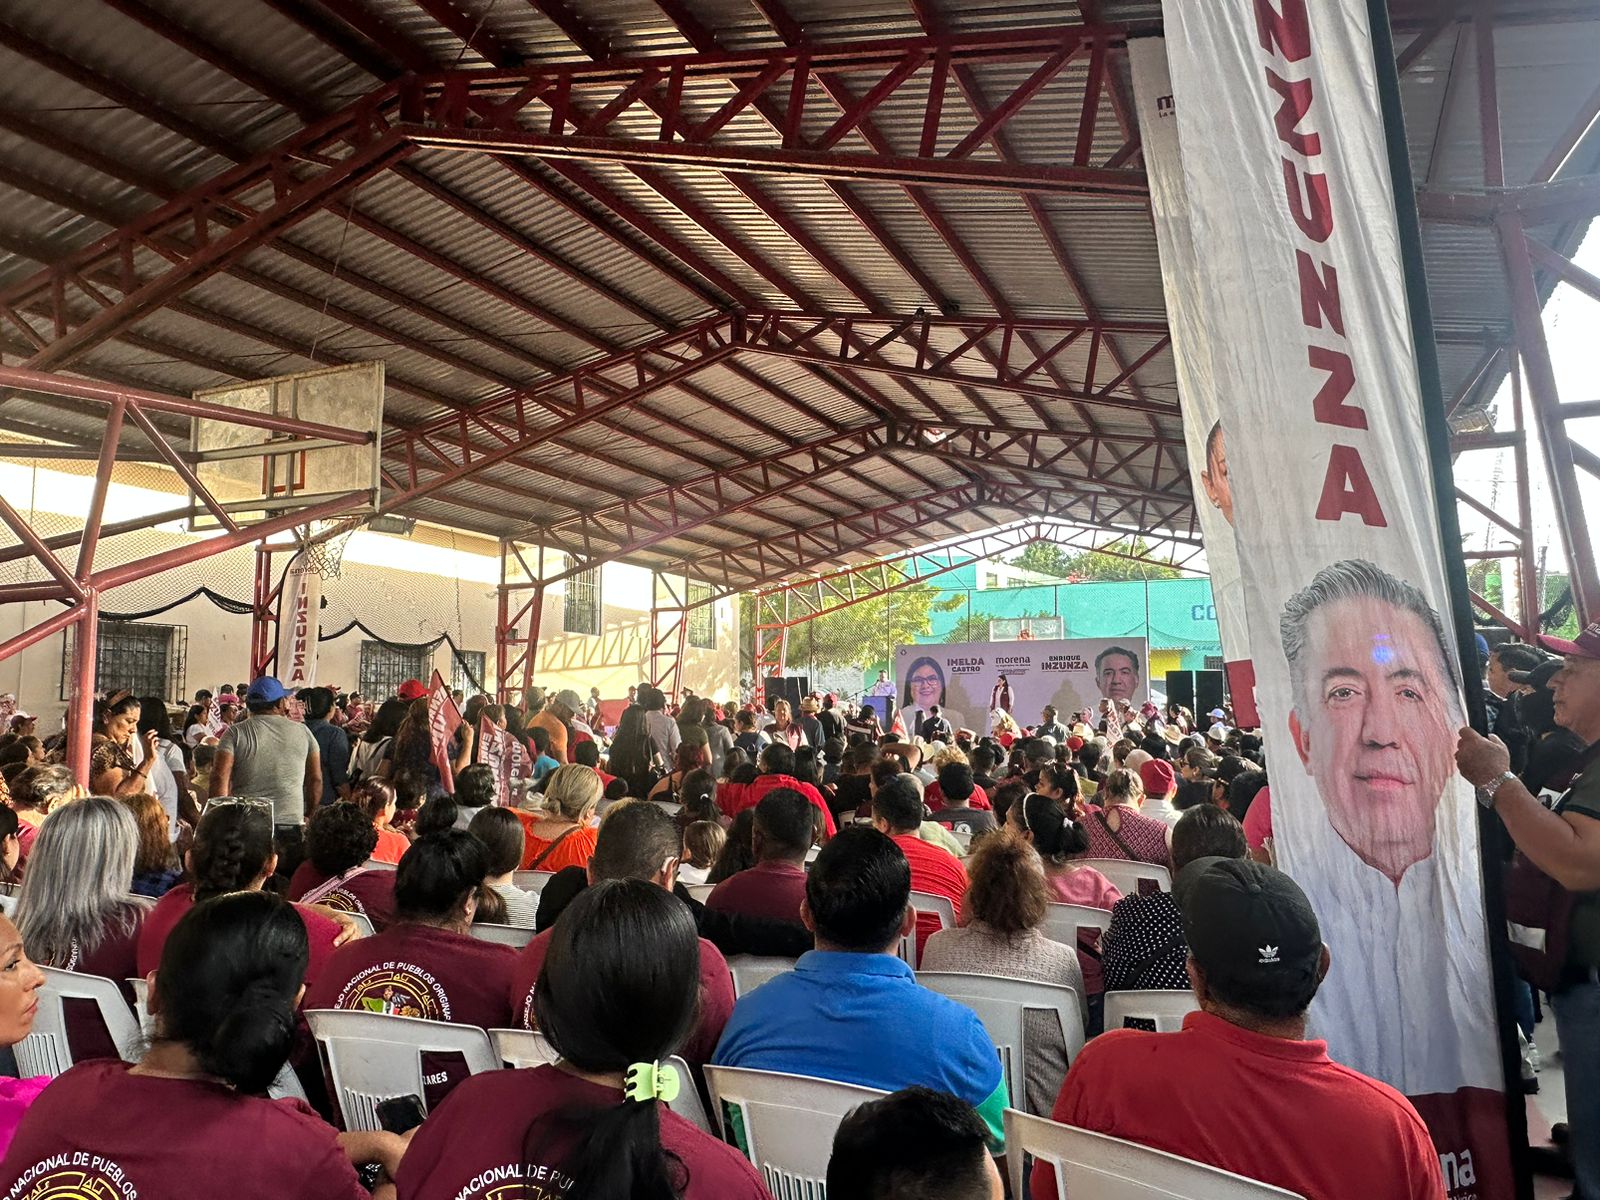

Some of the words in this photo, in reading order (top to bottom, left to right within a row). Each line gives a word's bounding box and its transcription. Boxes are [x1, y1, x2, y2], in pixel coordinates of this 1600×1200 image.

[947, 657, 985, 666] IMELDA
[995, 656, 1031, 664] morena
[1041, 661, 1089, 670] INZUNZA
[343, 964, 381, 993] NACIONAL
[397, 962, 436, 984] PUEBLOS
[10, 1153, 70, 1197] NACIONAL
[72, 1151, 90, 1166] DE
[91, 1155, 138, 1200] PUEBLOS
